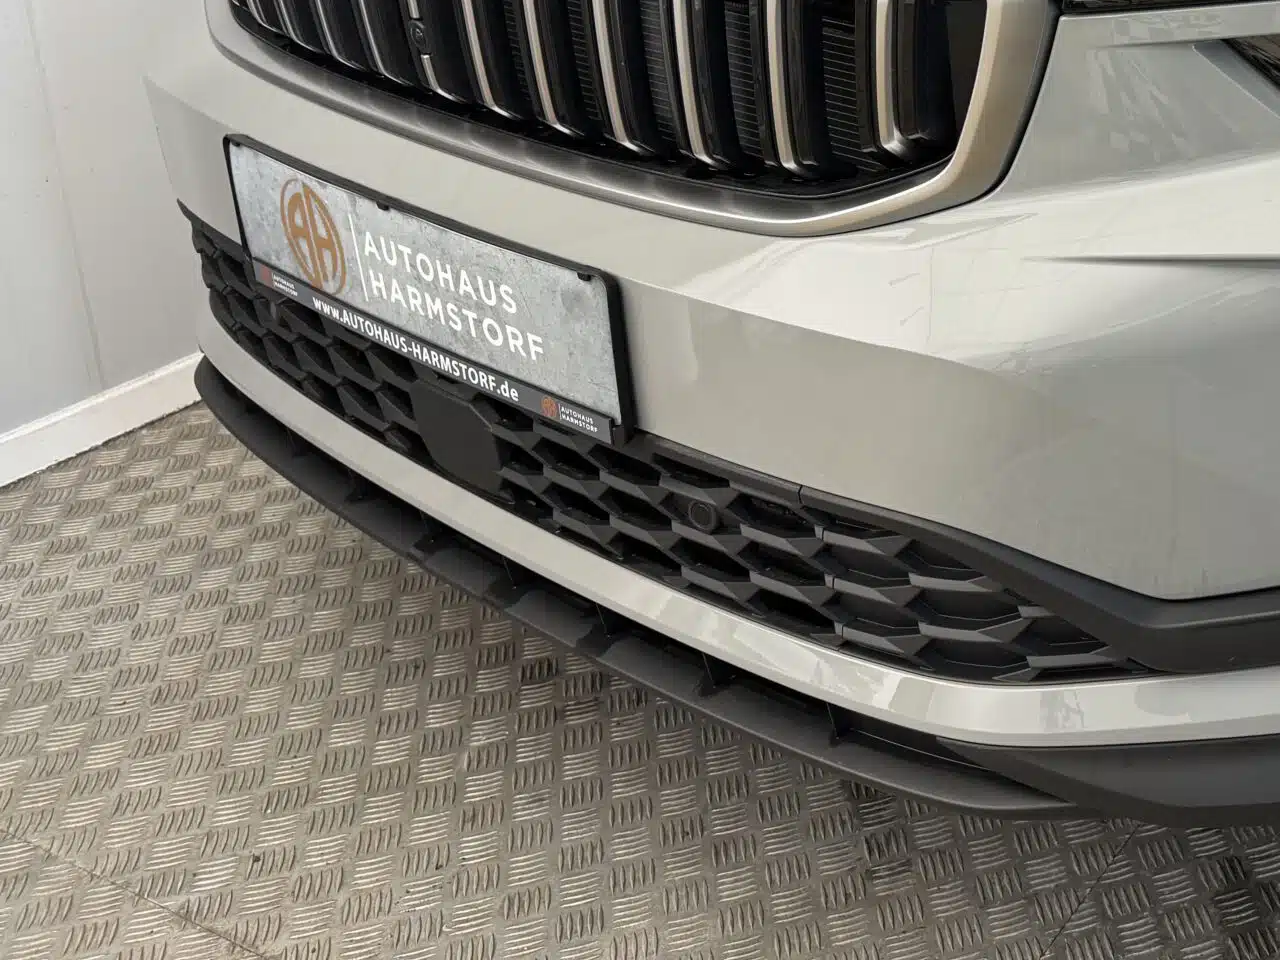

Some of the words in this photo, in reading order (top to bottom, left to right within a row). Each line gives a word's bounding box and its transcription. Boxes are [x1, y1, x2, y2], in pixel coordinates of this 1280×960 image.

[364, 231, 518, 314] AUTOHAUS
[368, 269, 545, 361] HARMSTORF
[312, 296, 519, 402] www.AUTOHAUS-HARMSTORF.de
[561, 406, 594, 424] AUTOHAUS
